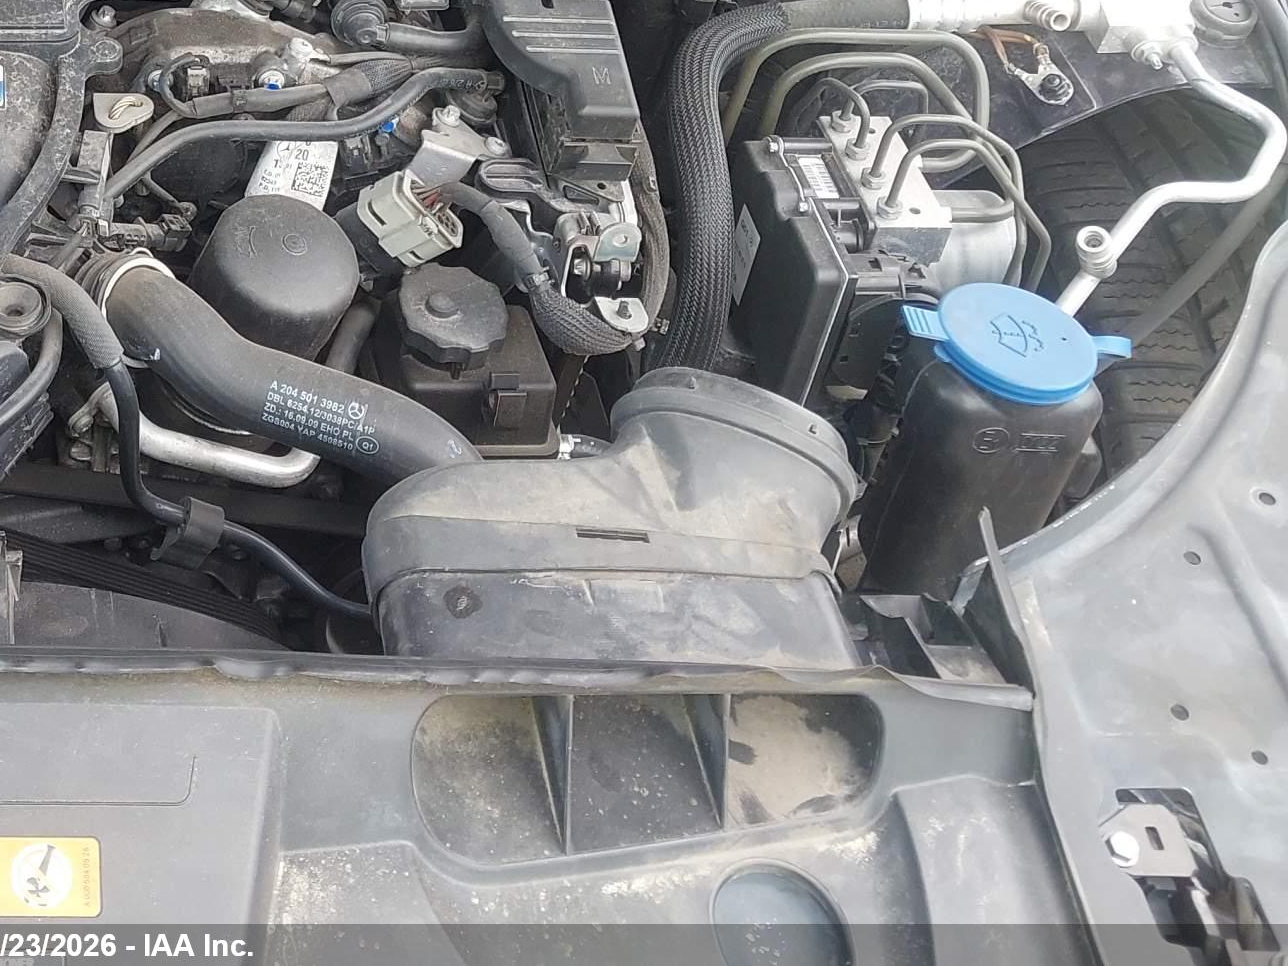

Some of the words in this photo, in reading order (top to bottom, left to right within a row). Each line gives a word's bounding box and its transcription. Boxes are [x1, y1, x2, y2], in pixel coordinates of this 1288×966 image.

[592, 65, 611, 84] M
[267, 392, 285, 405] DBL
[270, 380, 278, 391] A
[280, 384, 298, 397] 204
[300, 391, 318, 404] 501
[320, 398, 345, 414] 3982
